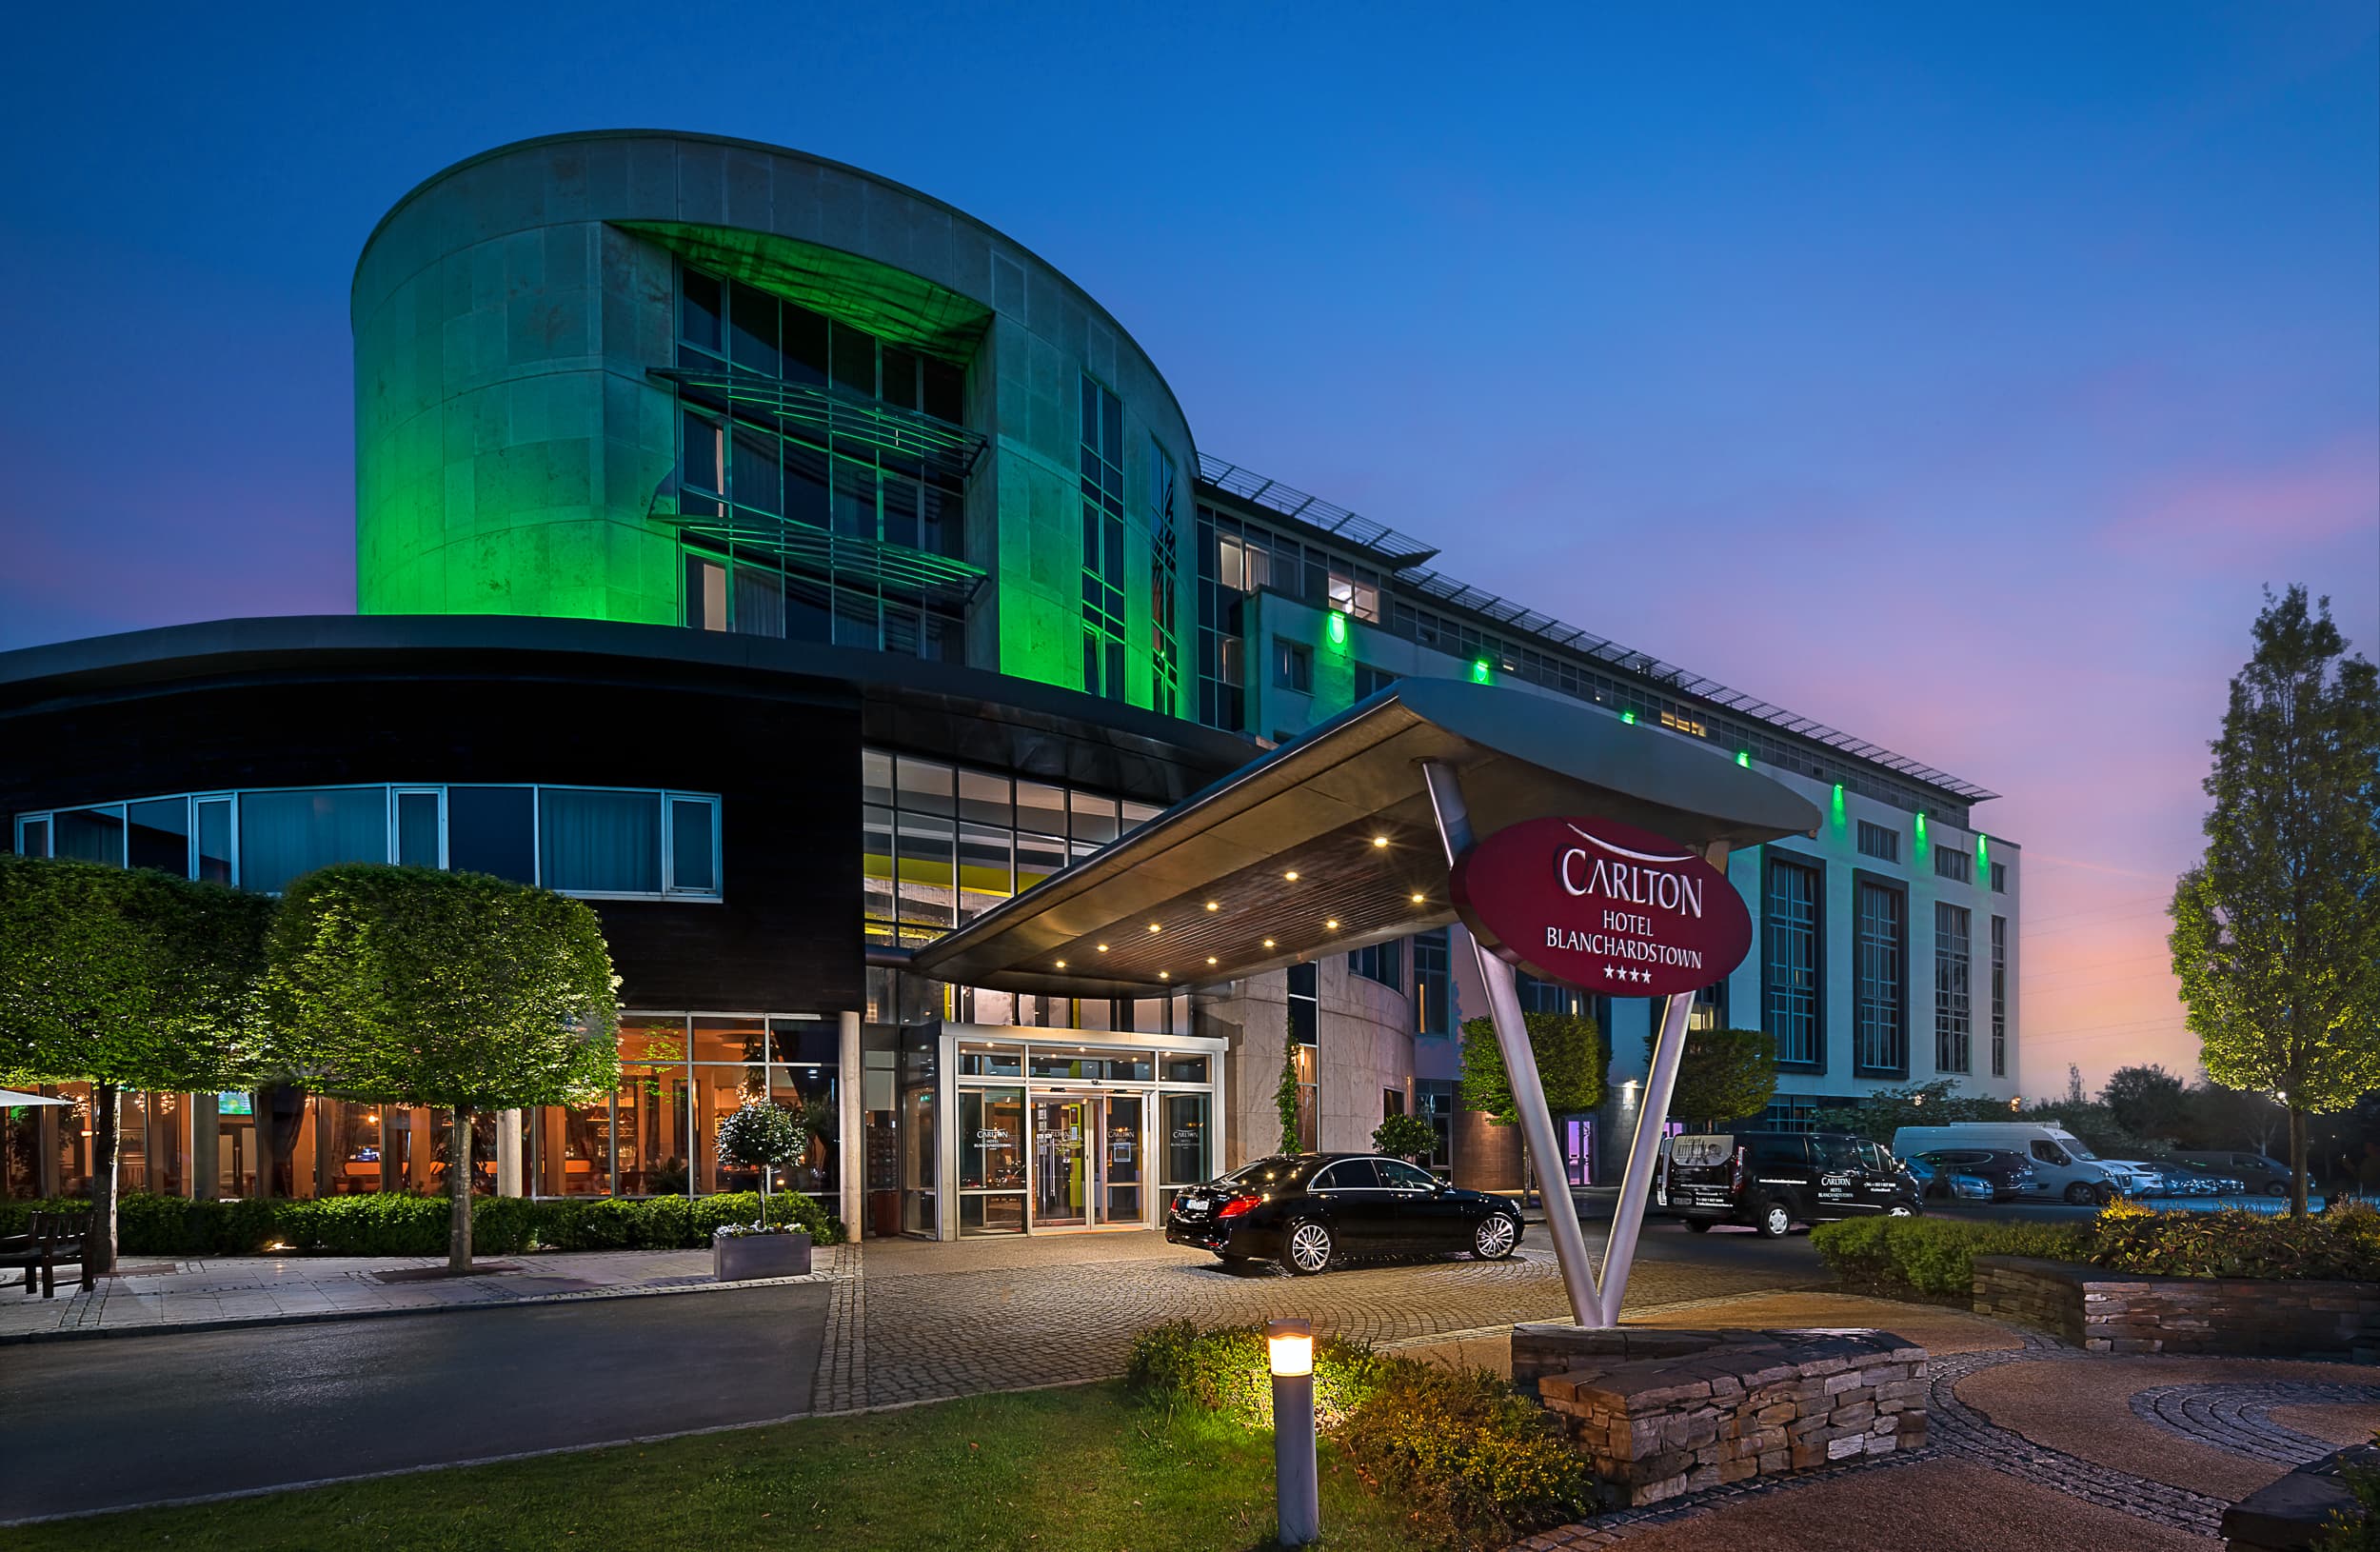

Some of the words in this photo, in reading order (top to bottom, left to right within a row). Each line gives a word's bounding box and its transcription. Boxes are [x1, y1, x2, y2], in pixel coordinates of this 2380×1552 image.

[1561, 847, 1702, 918] CARLTON
[1603, 909, 1654, 937] HOTEL
[1546, 926, 1702, 970] BLANCHARDSTOWN
[1820, 1177, 1851, 1186] CARLTON
